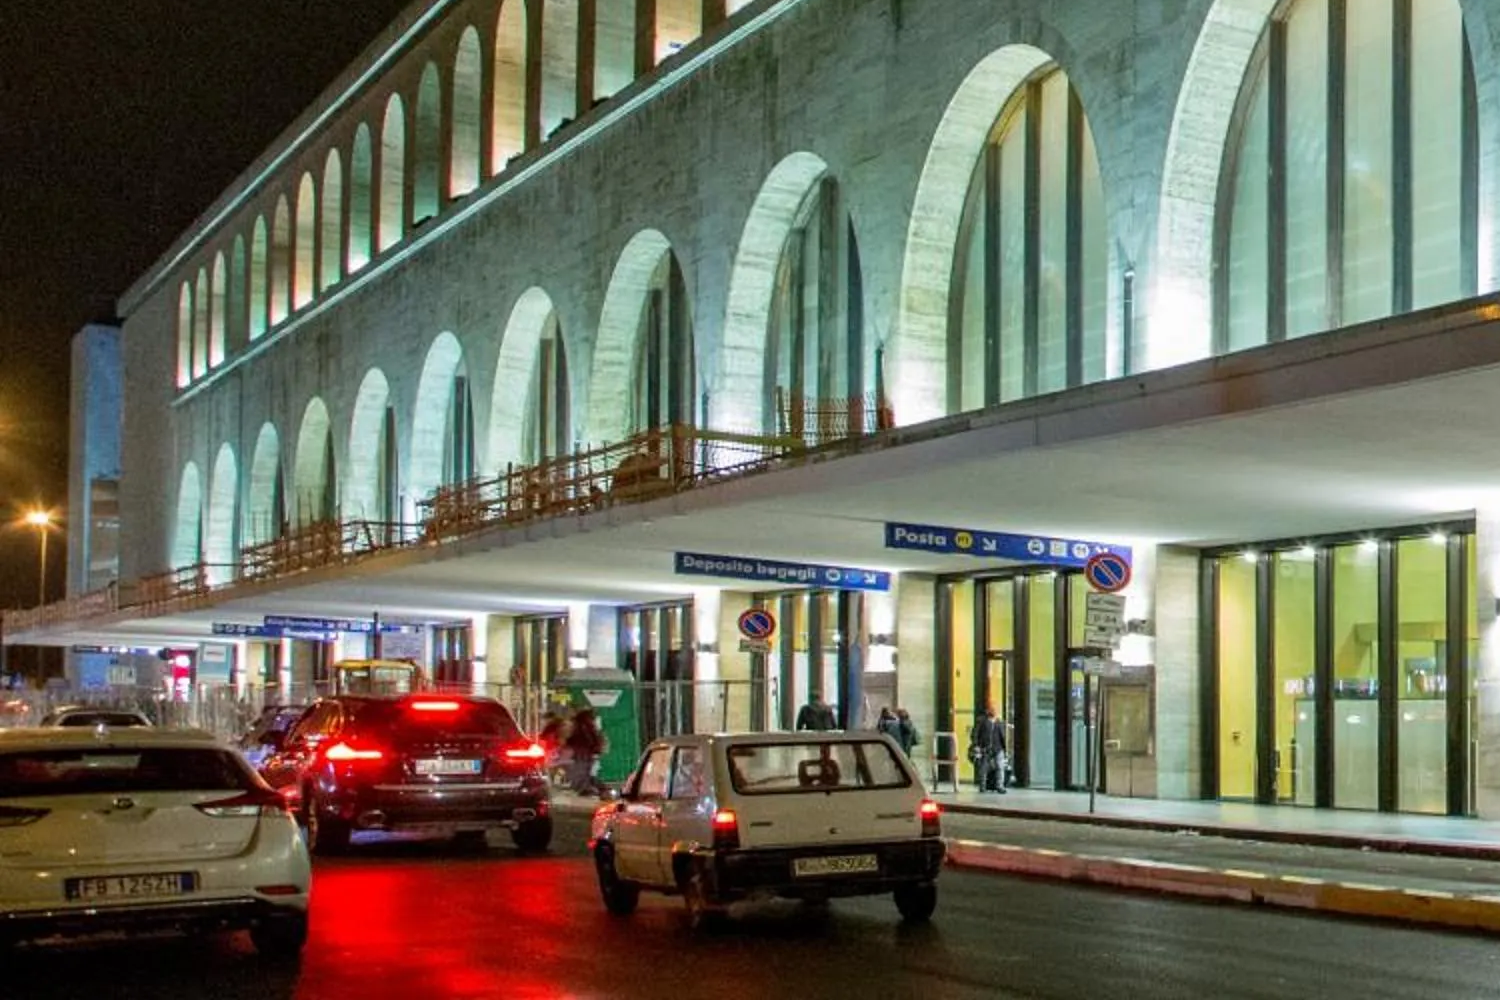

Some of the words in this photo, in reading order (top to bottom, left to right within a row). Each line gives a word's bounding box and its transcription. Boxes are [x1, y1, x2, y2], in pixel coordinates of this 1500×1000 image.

[895, 527, 947, 547] Posta
[683, 555, 753, 573] Deposito
[756, 564, 816, 581] bagagli
